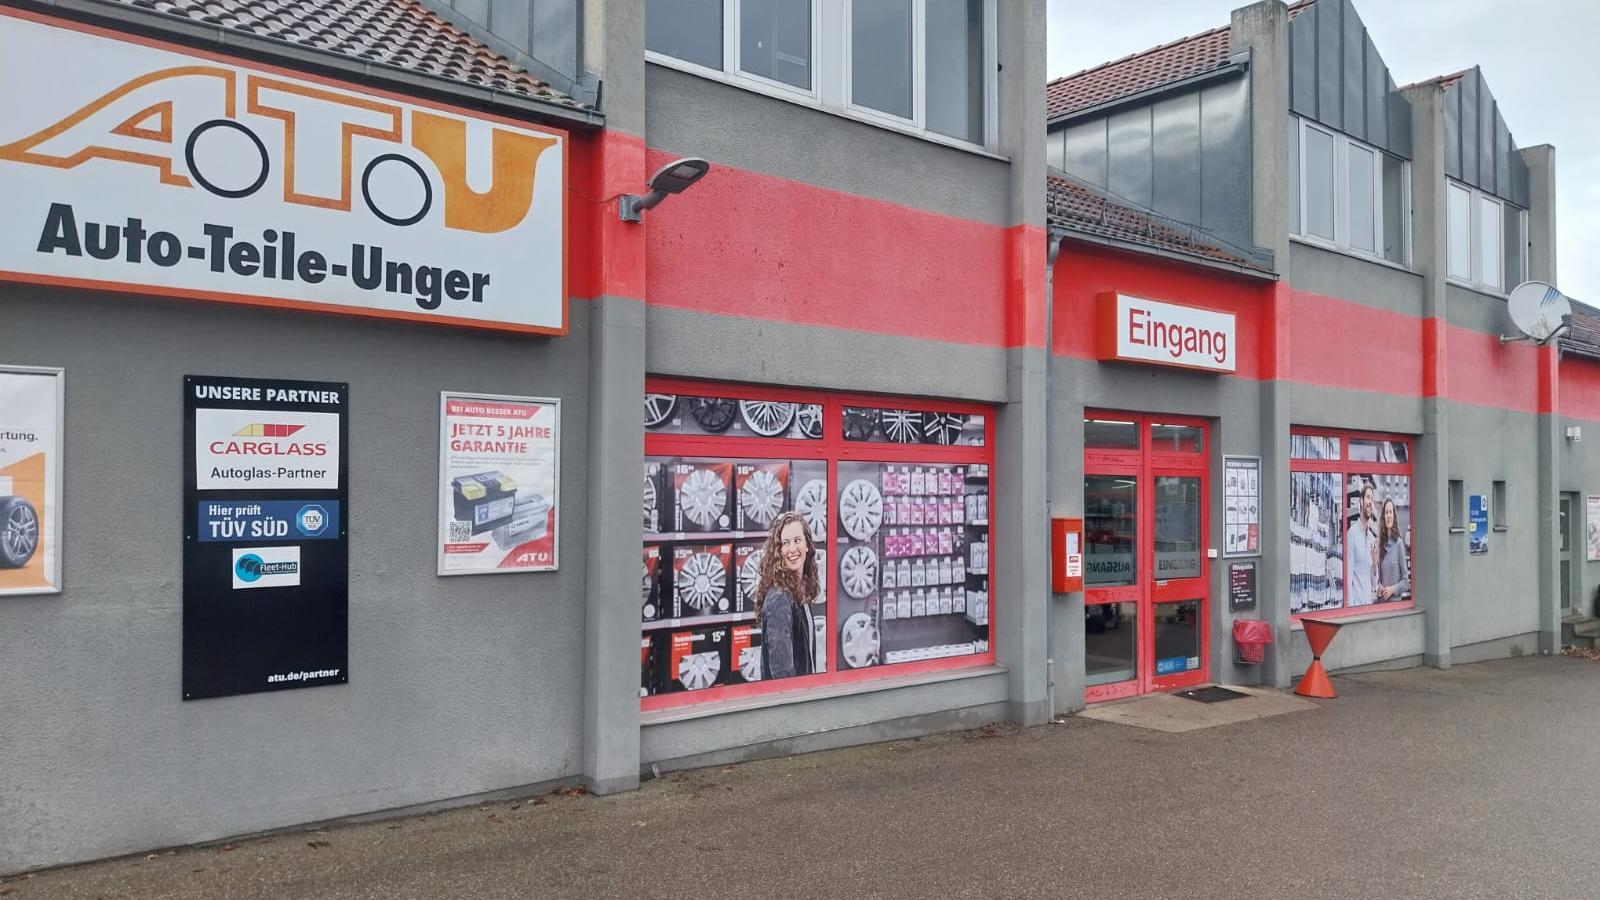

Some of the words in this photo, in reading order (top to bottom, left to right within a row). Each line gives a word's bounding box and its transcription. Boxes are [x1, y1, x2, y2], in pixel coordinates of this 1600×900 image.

[0, 65, 558, 234] ATU
[36, 202, 491, 311] Auto-Teile-Unger
[1128, 307, 1227, 364] Eingang
[195, 385, 261, 401] UNSERE
[266, 388, 340, 404] PARTNER
[464, 406, 485, 414] AUTO
[513, 408, 527, 416] ATU
[450, 423, 493, 438] JETZT
[497, 425, 505, 437] 5
[507, 425, 551, 440] JAHRE
[210, 441, 327, 456] CARGLASS
[450, 440, 527, 453] GARANTIE
[210, 467, 327, 481] Autoglas-Partner
[208, 505, 232, 516] Hier
[235, 505, 261, 518] prüft
[208, 518, 246, 539] TÜV
[251, 516, 289, 538] SÜD
[516, 552, 548, 563] ATU
[1158, 559, 1196, 570] EINGG
[260, 563, 297, 571] Fleet-Hub
[267, 668, 340, 683] atu.de/partner
